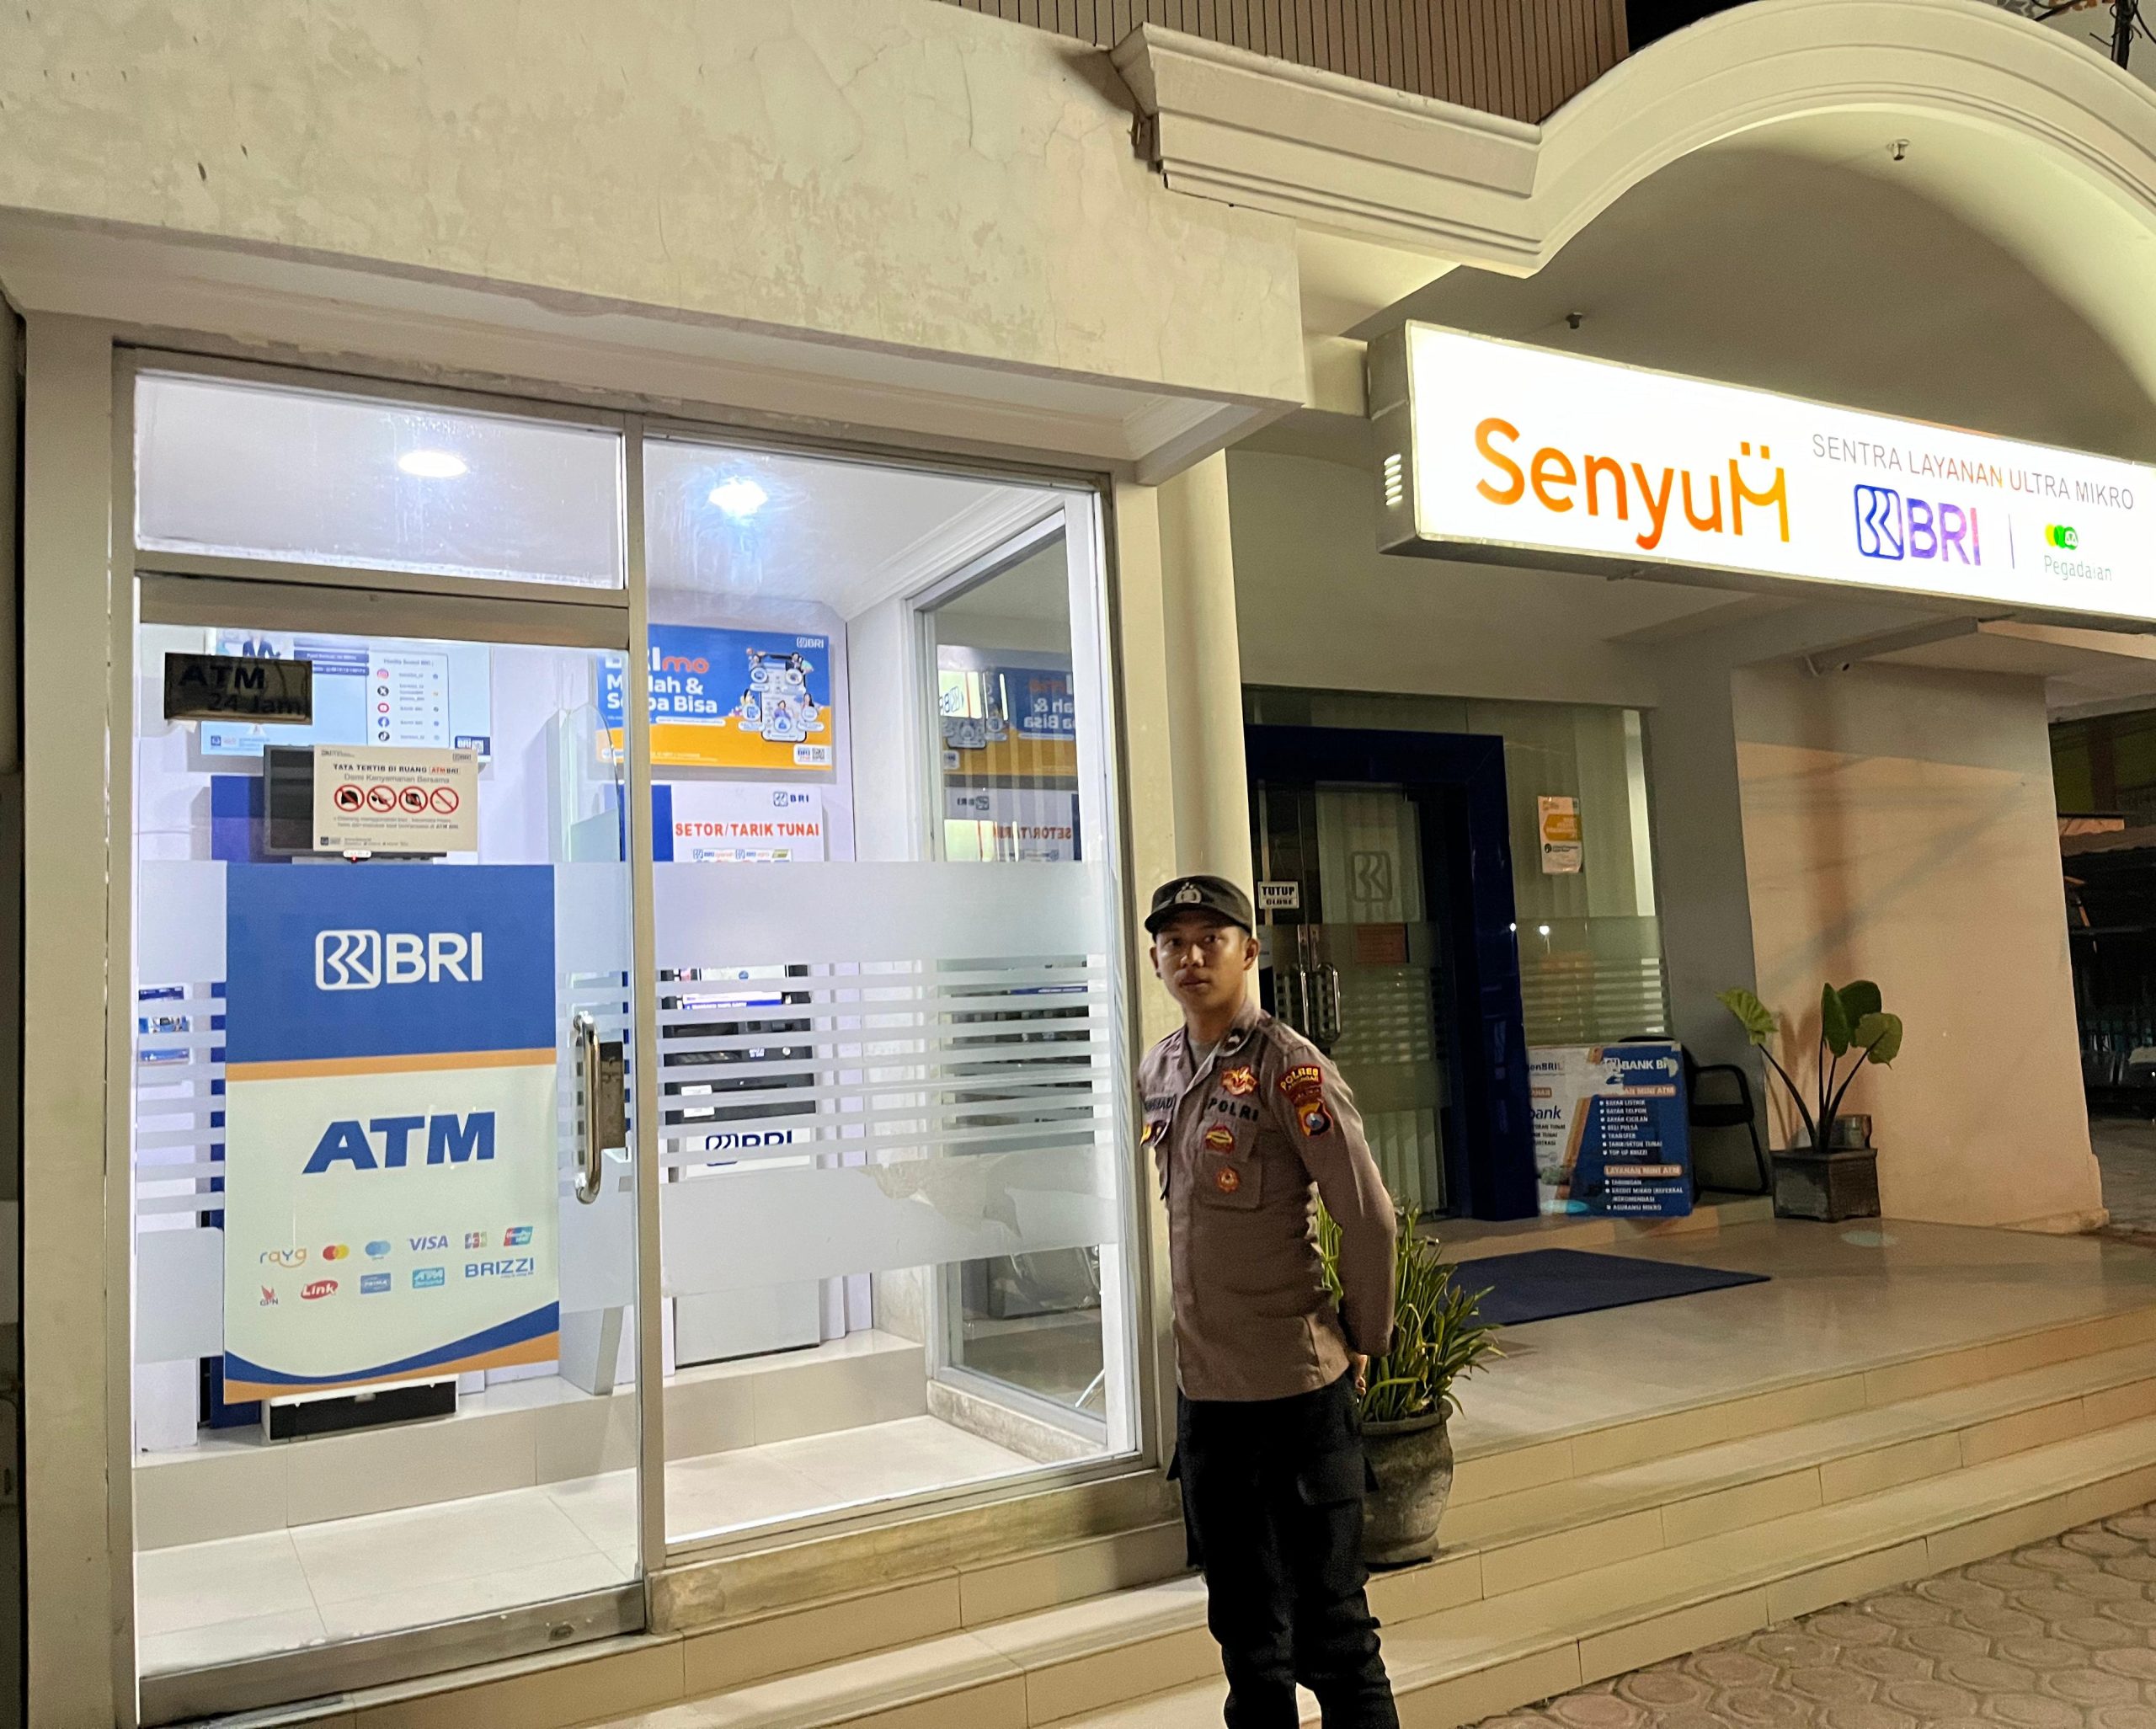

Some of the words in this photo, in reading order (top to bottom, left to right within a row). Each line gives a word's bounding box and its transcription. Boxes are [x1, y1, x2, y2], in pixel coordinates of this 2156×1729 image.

[1812, 434, 1903, 472] SENTRA
[1908, 451, 2003, 488] LAYANAN
[2009, 468, 2071, 500] ULTRA
[2075, 480, 2134, 510] MIKRO
[1906, 497, 1982, 567] BRI
[2044, 554, 2113, 581] Pegadaian
[178, 663, 265, 690] ATM
[686, 677, 704, 696] &
[209, 691, 238, 712] 24
[674, 695, 718, 714] Bisa
[333, 763, 354, 771] TATA
[356, 764, 386, 772] TERTIB
[417, 776, 451, 784] Bersama
[675, 823, 774, 836] SETOR/TARIK
[776, 823, 819, 836] TUNAI
[1262, 886, 1295, 896] TUTUP
[386, 931, 483, 985] BRI
[1621, 1059, 1654, 1070] BANK
[1657, 1086, 1674, 1095] ATM
[1208, 1097, 1259, 1122] POLRI
[302, 1111, 496, 1174] ATM
[408, 1235, 449, 1251] VISA
[302, 1283, 335, 1297] Link
[465, 1257, 534, 1278] BRIZZI
